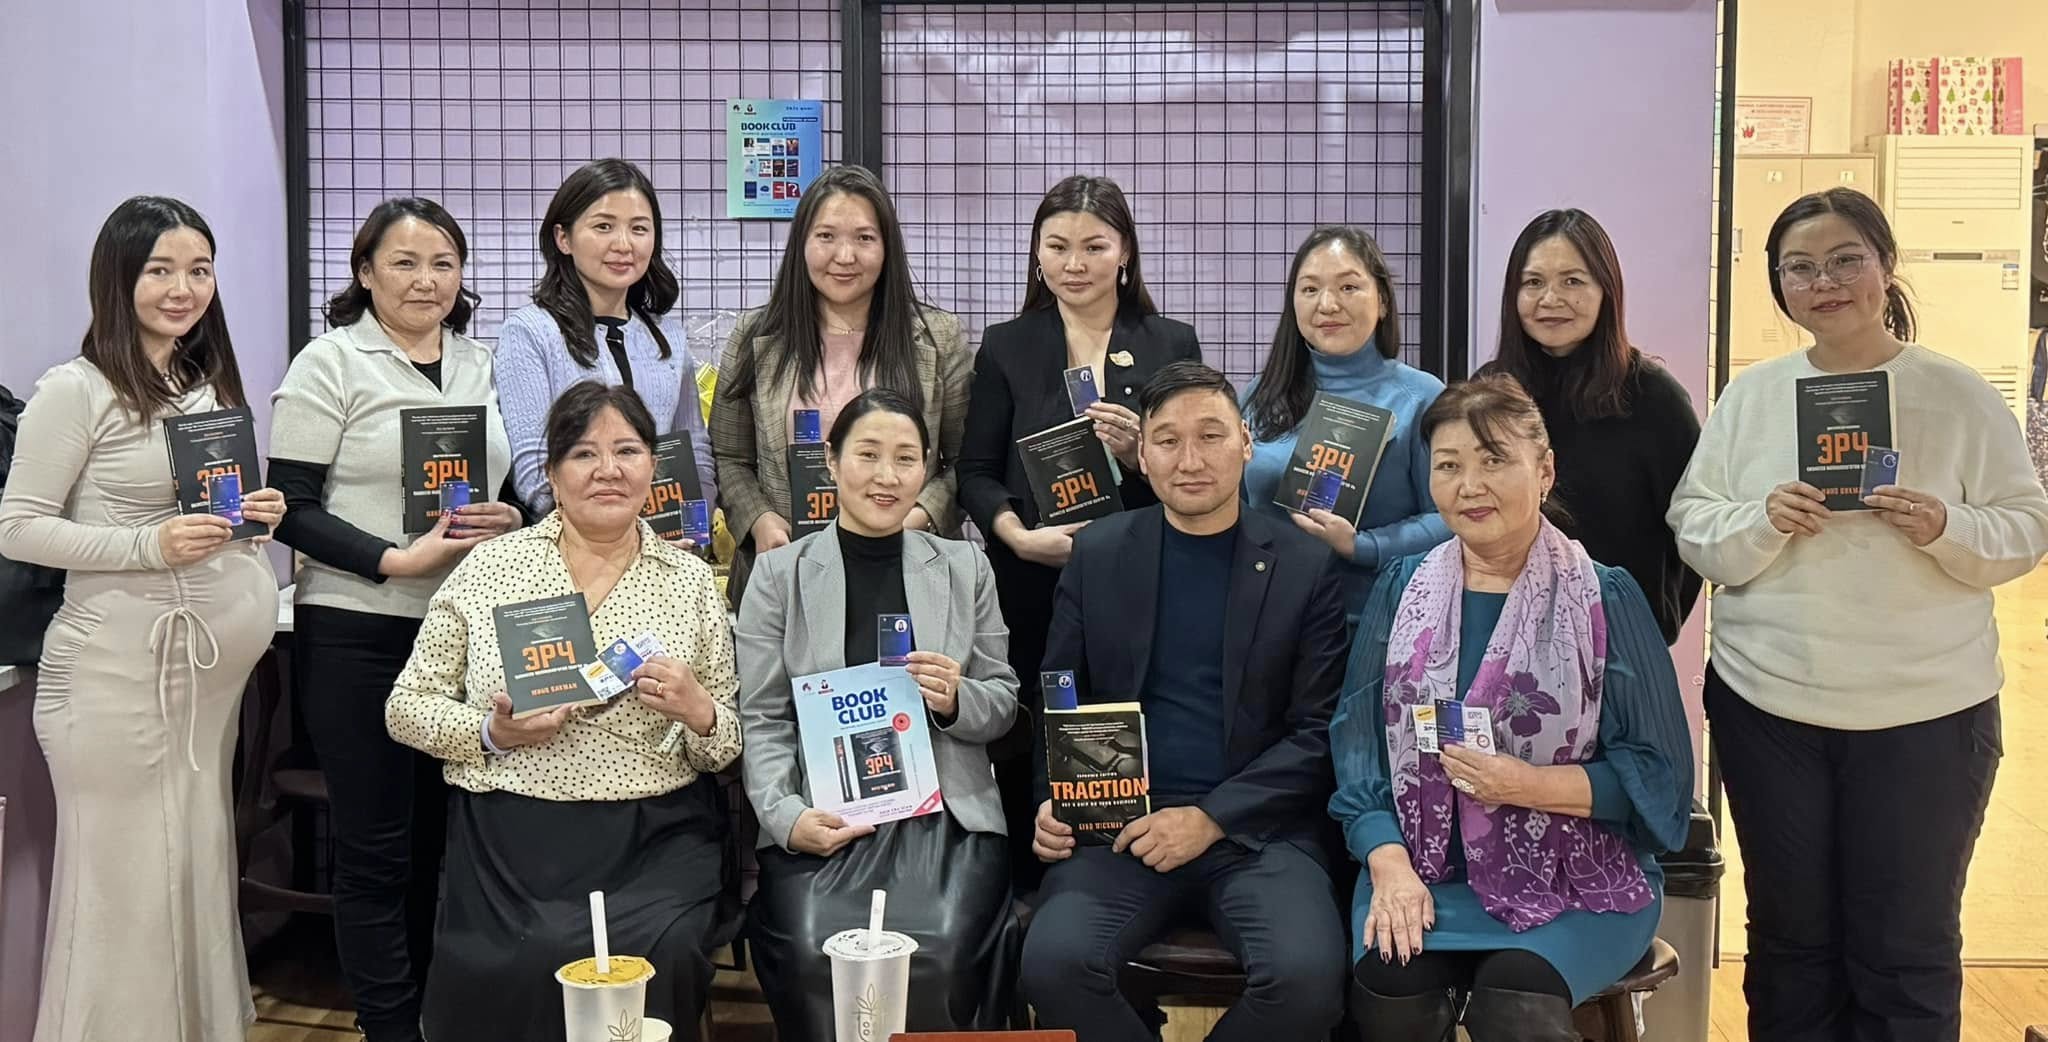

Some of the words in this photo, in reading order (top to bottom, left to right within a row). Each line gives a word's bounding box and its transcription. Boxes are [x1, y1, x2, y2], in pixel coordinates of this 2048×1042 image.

[741, 122, 770, 131] BOOK
[771, 122, 796, 131] CLUB
[1051, 472, 1099, 509] ЭРЧ
[806, 492, 835, 519] ЭР
[522, 640, 576, 671] ЭРЧ
[832, 687, 888, 711] BOOK
[838, 703, 886, 725] CLUB
[1050, 778, 1146, 800] TRACTION
